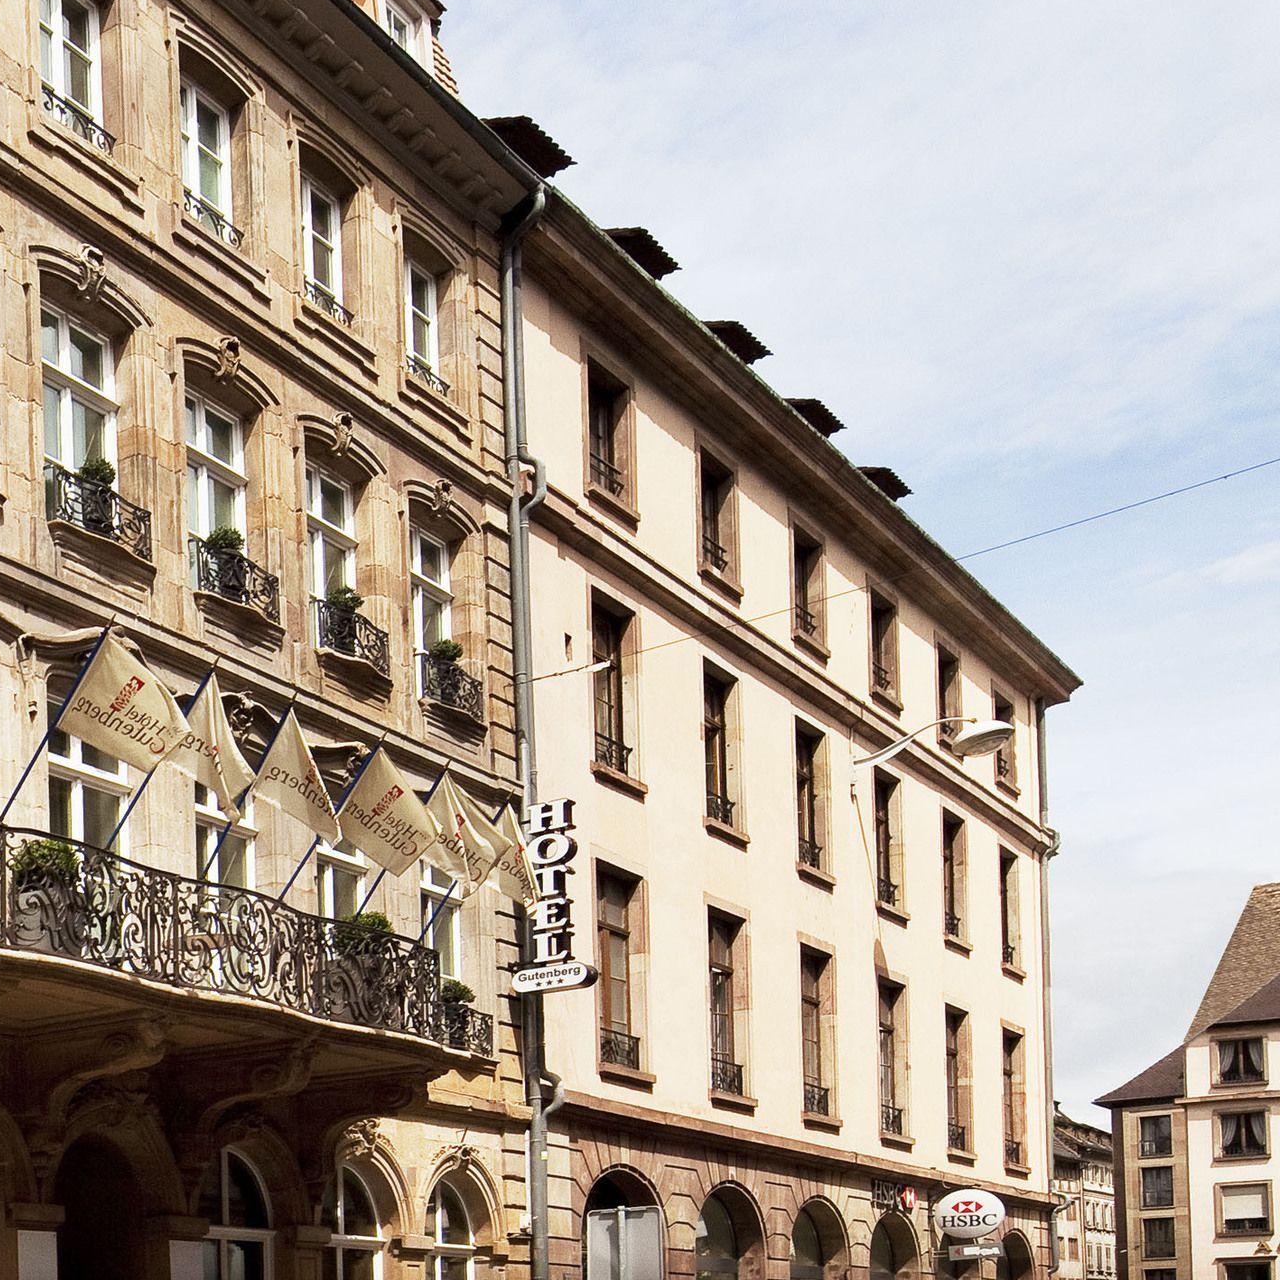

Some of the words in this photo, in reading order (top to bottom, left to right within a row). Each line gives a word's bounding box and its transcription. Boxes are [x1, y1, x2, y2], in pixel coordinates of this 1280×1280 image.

[527, 799, 575, 963] HOTEL
[518, 967, 581, 982] Gutenberg
[941, 1214, 997, 1227] HSBC
